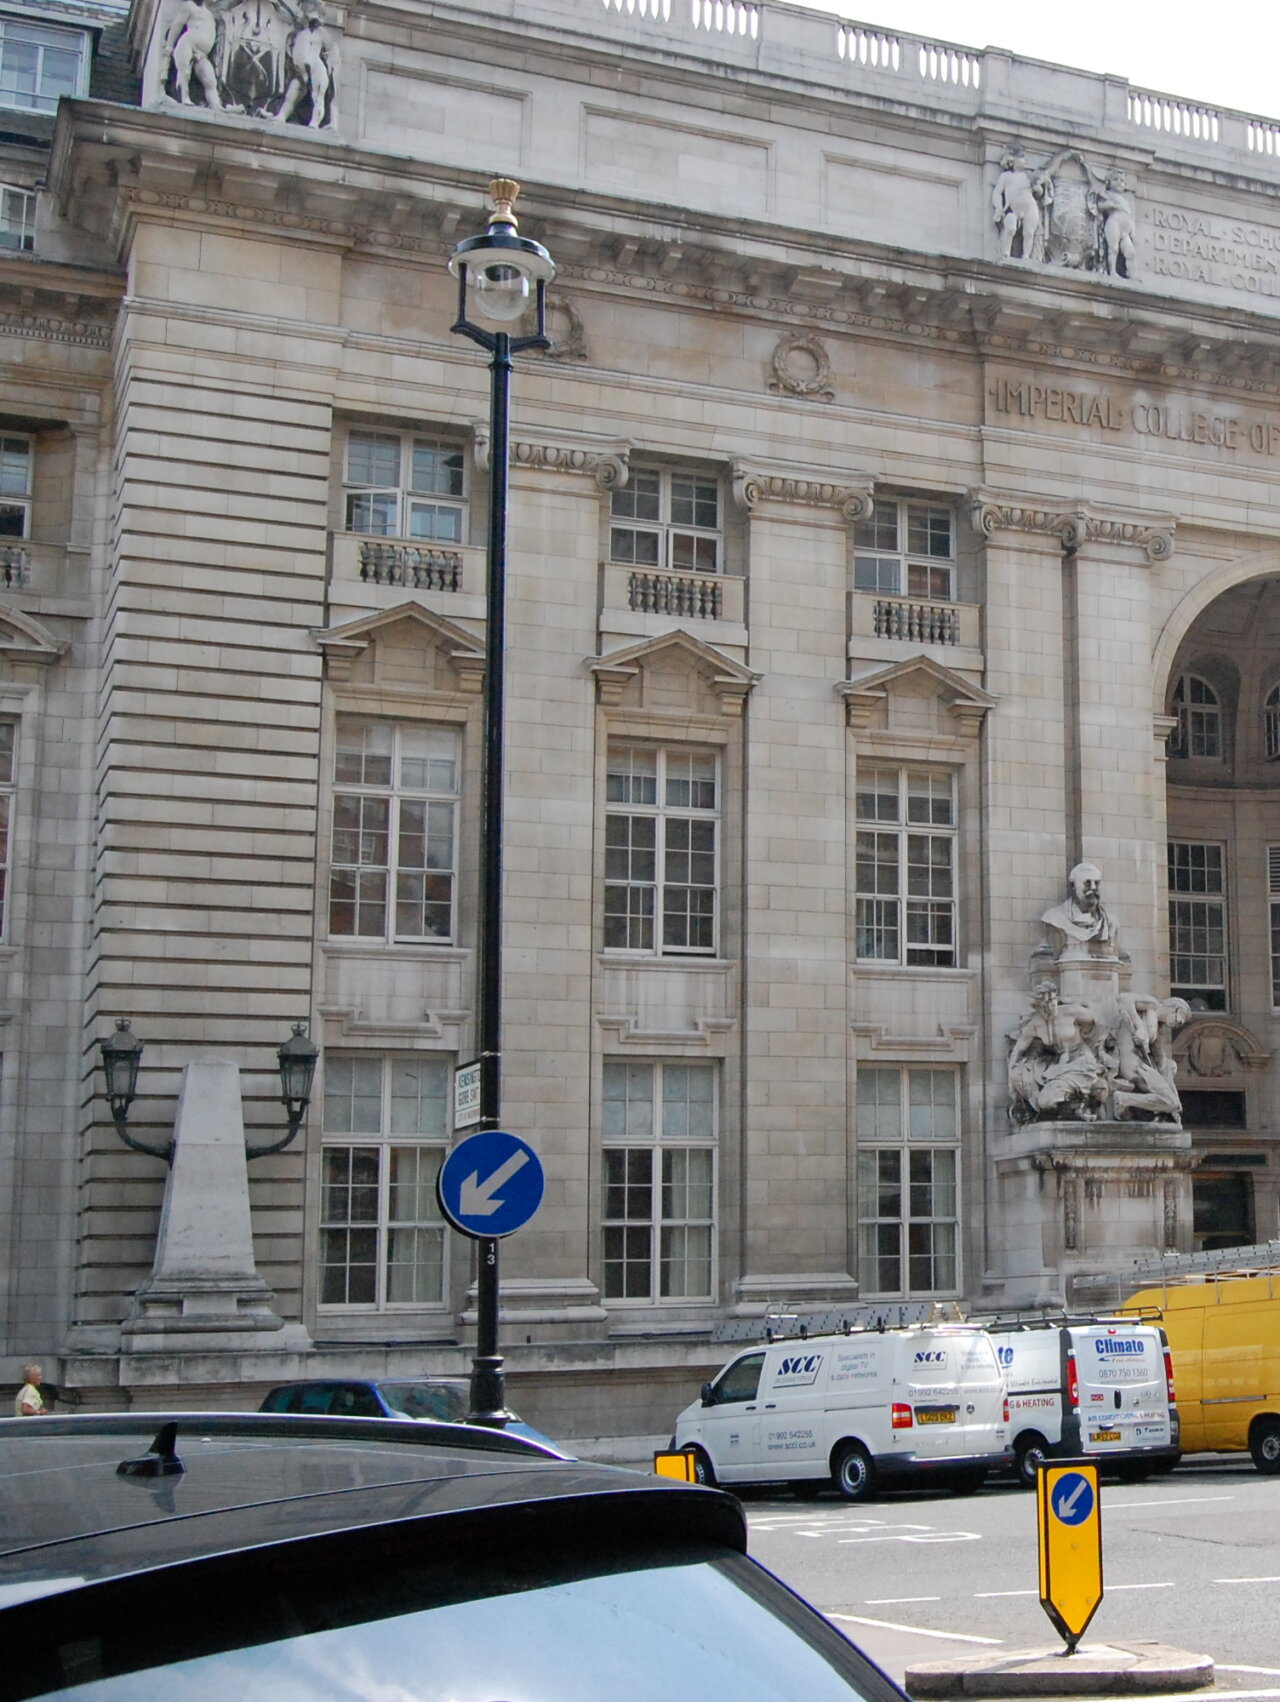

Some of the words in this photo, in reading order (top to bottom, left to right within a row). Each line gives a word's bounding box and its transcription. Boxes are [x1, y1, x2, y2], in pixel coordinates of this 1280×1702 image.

[1153, 208, 1222, 240] ROYAL
[1154, 257, 1223, 286] ROYAL
[995, 378, 1121, 431] IMPERIAL
[1131, 403, 1239, 450] COLLEGE
[1095, 1338, 1145, 1354] Climate
[777, 1354, 822, 1376] SCC
[914, 1351, 947, 1364] SCC
[1099, 1369, 1118, 1379] 0870
[1118, 1368, 1131, 1378] 750
[1015, 1400, 1022, 1409] &
[1022, 1397, 1055, 1408] HEATING
